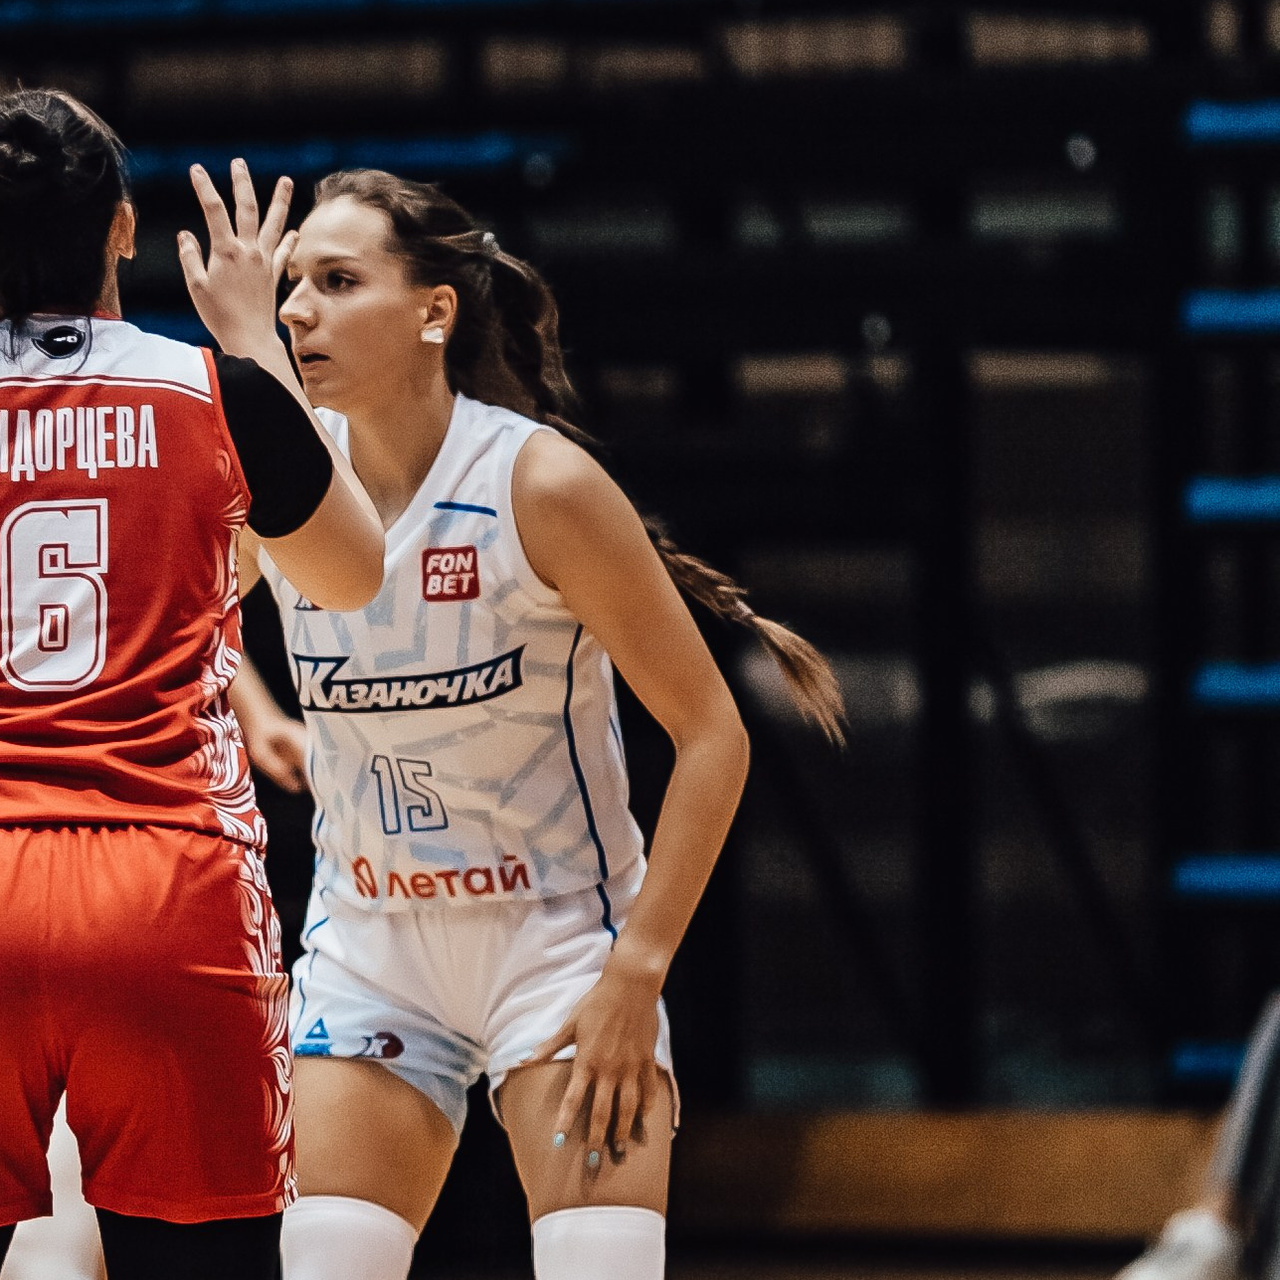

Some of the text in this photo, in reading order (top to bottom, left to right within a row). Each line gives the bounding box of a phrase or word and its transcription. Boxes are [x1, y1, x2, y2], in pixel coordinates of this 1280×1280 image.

[426, 552, 474, 574] FON
[426, 572, 475, 596] BET
[0, 497, 109, 692] 6
[370, 754, 449, 836] 15
